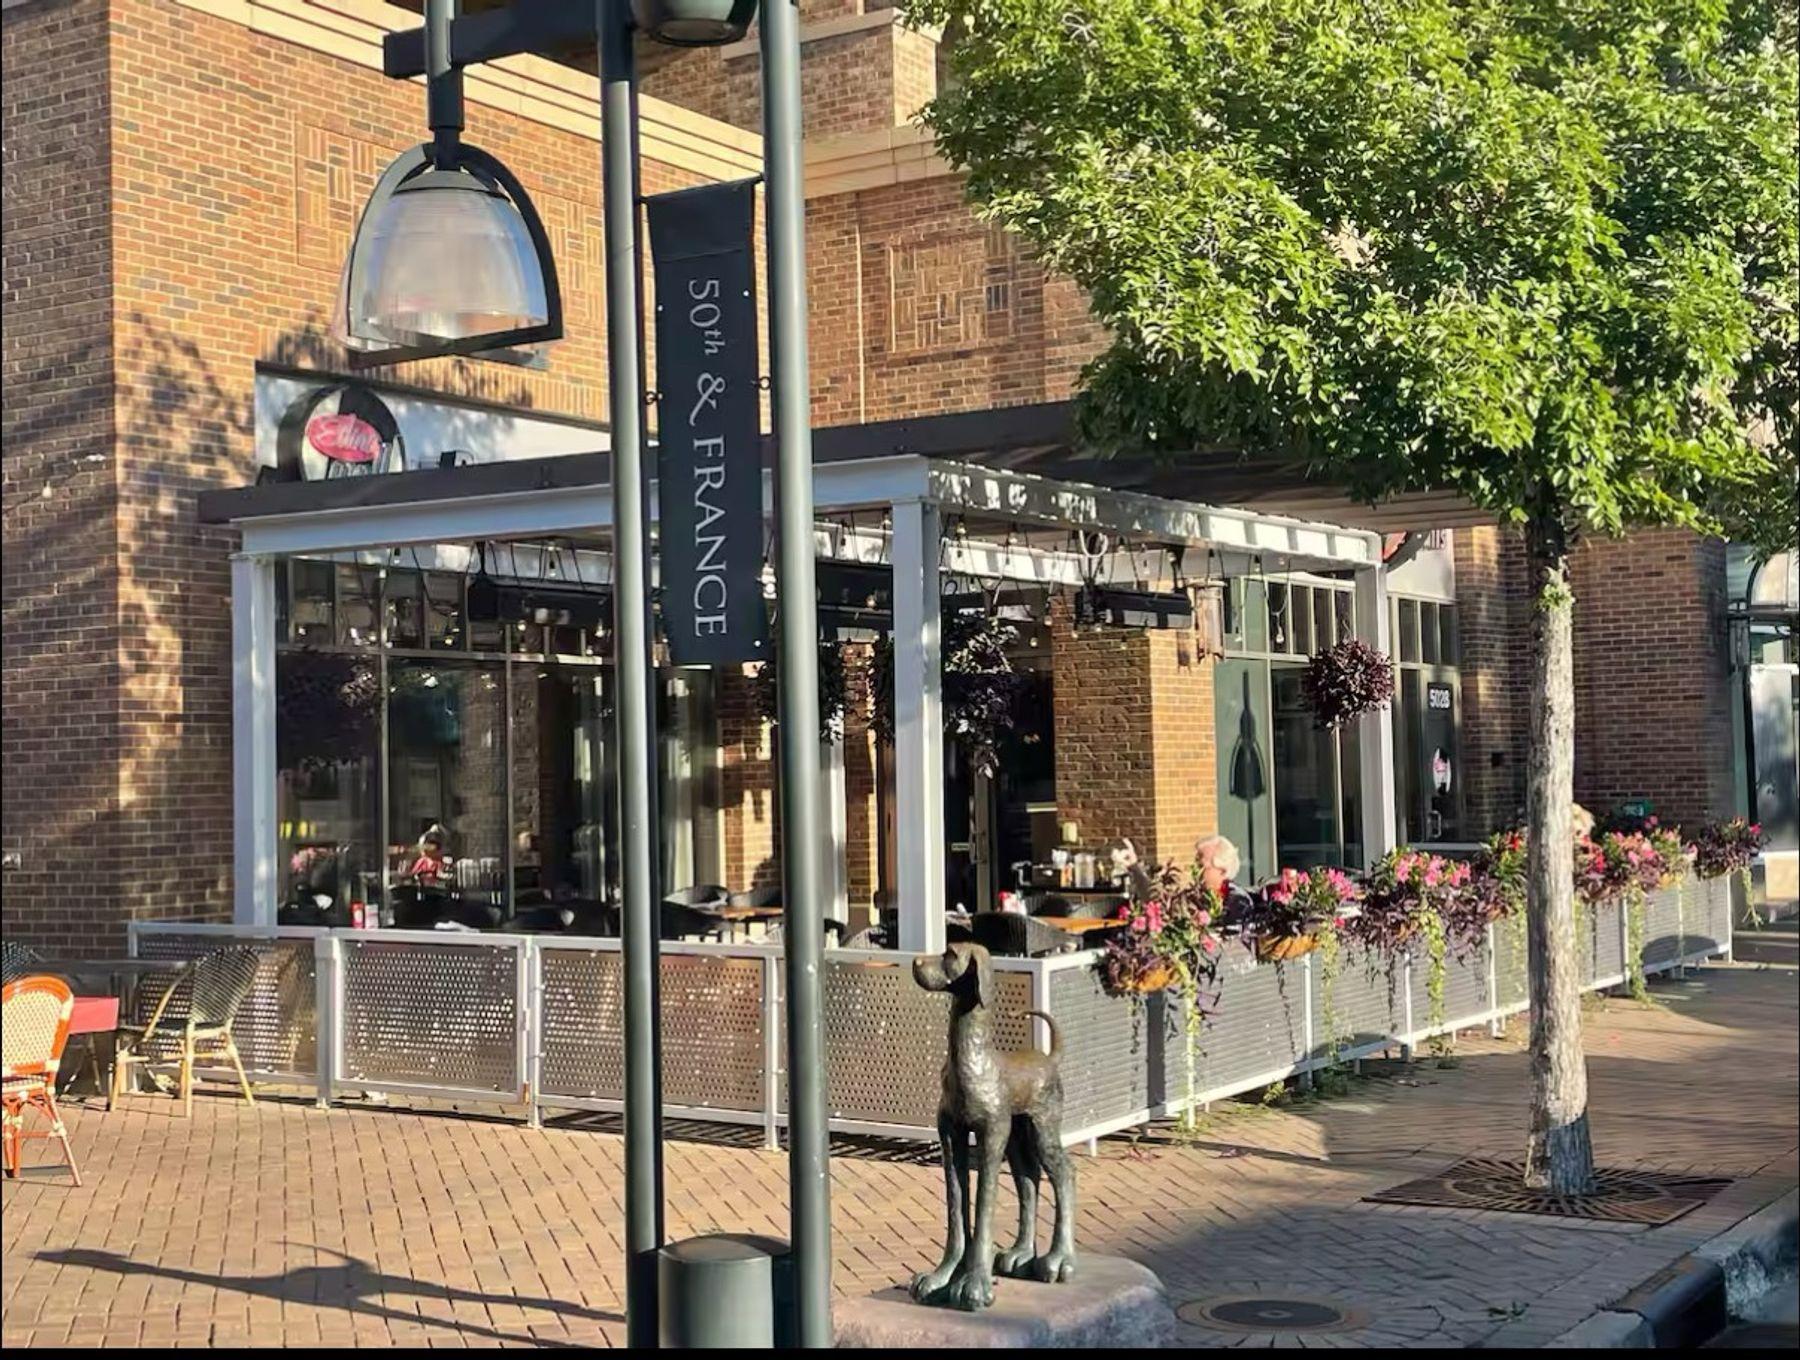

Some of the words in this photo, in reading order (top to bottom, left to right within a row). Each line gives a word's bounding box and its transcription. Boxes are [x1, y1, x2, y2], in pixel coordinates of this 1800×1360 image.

[688, 279, 726, 355] 50th
[689, 372, 726, 427] &
[693, 435, 727, 637] FRANCE
